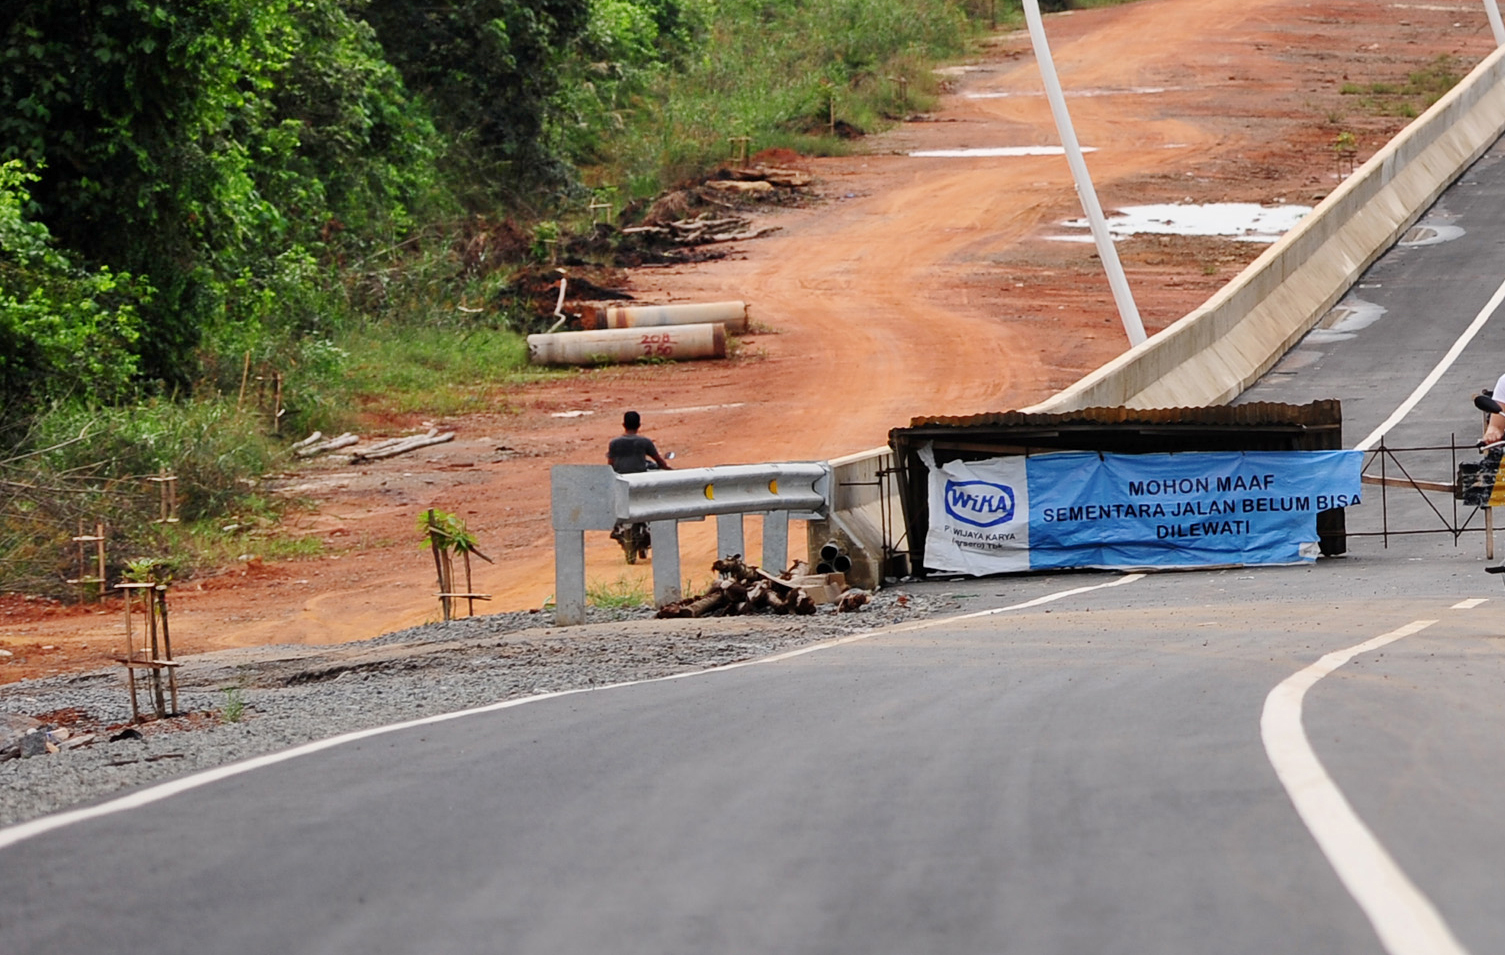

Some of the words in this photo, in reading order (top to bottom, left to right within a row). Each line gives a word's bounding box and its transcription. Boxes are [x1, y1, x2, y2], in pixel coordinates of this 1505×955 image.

[1128, 478, 1209, 497] MOHON
[1217, 474, 1275, 491] MAAF
[1043, 503, 1166, 523] SEMENTARA
[1170, 499, 1238, 518] JALAN
[1242, 496, 1310, 513] BELUM
[1316, 493, 1363, 510] BISA
[954, 528, 984, 541] WIJAYA
[986, 533, 1016, 542] KARYA
[1156, 520, 1251, 541] DILEWATI
